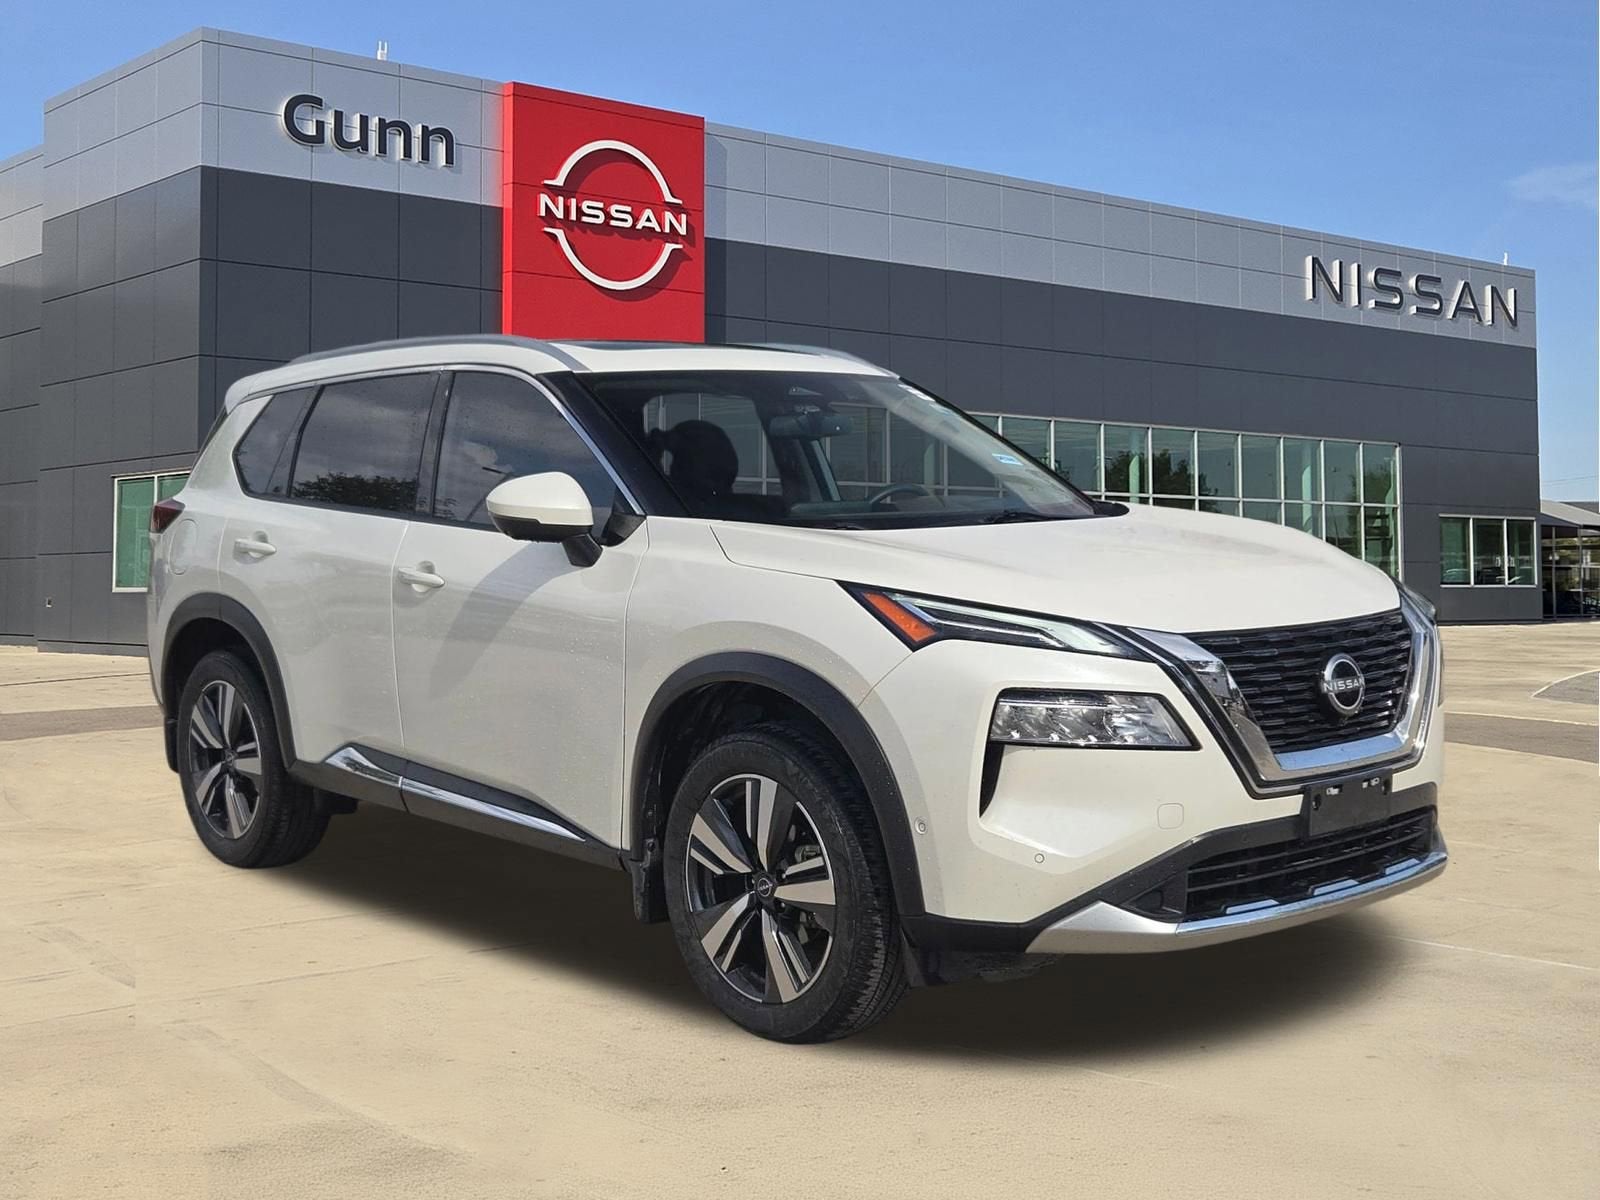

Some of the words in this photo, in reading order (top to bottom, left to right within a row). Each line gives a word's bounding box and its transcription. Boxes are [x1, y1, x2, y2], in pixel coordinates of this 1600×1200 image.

[282, 94, 455, 167] Gunn
[538, 193, 687, 236] NISSAN
[1305, 255, 1518, 328] NISSAN
